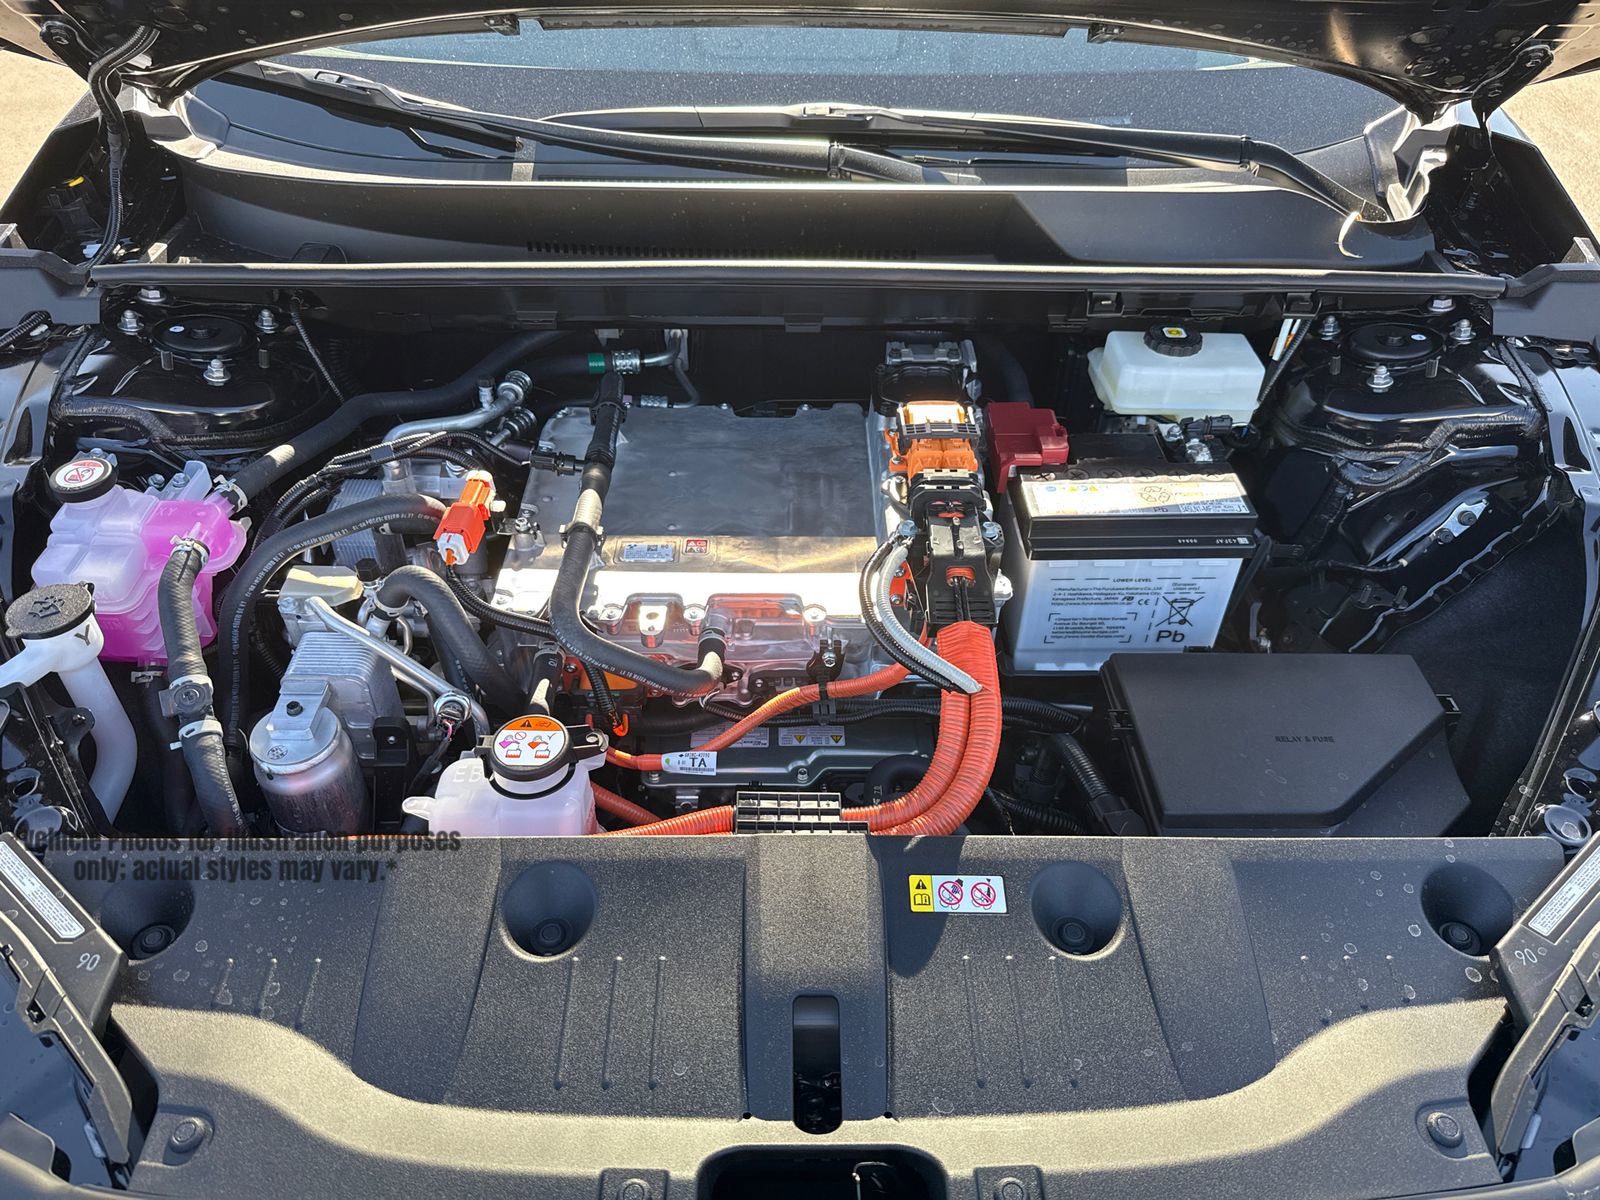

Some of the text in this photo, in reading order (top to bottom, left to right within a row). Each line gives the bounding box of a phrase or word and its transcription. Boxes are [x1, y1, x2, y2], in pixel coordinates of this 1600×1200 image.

[1155, 630, 1185, 643] Pb
[1274, 735, 1301, 743] RELAY
[1312, 735, 1335, 743] FUSE
[689, 757, 706, 767] TA
[75, 952, 100, 972] 90
[1514, 948, 1538, 966] 90
